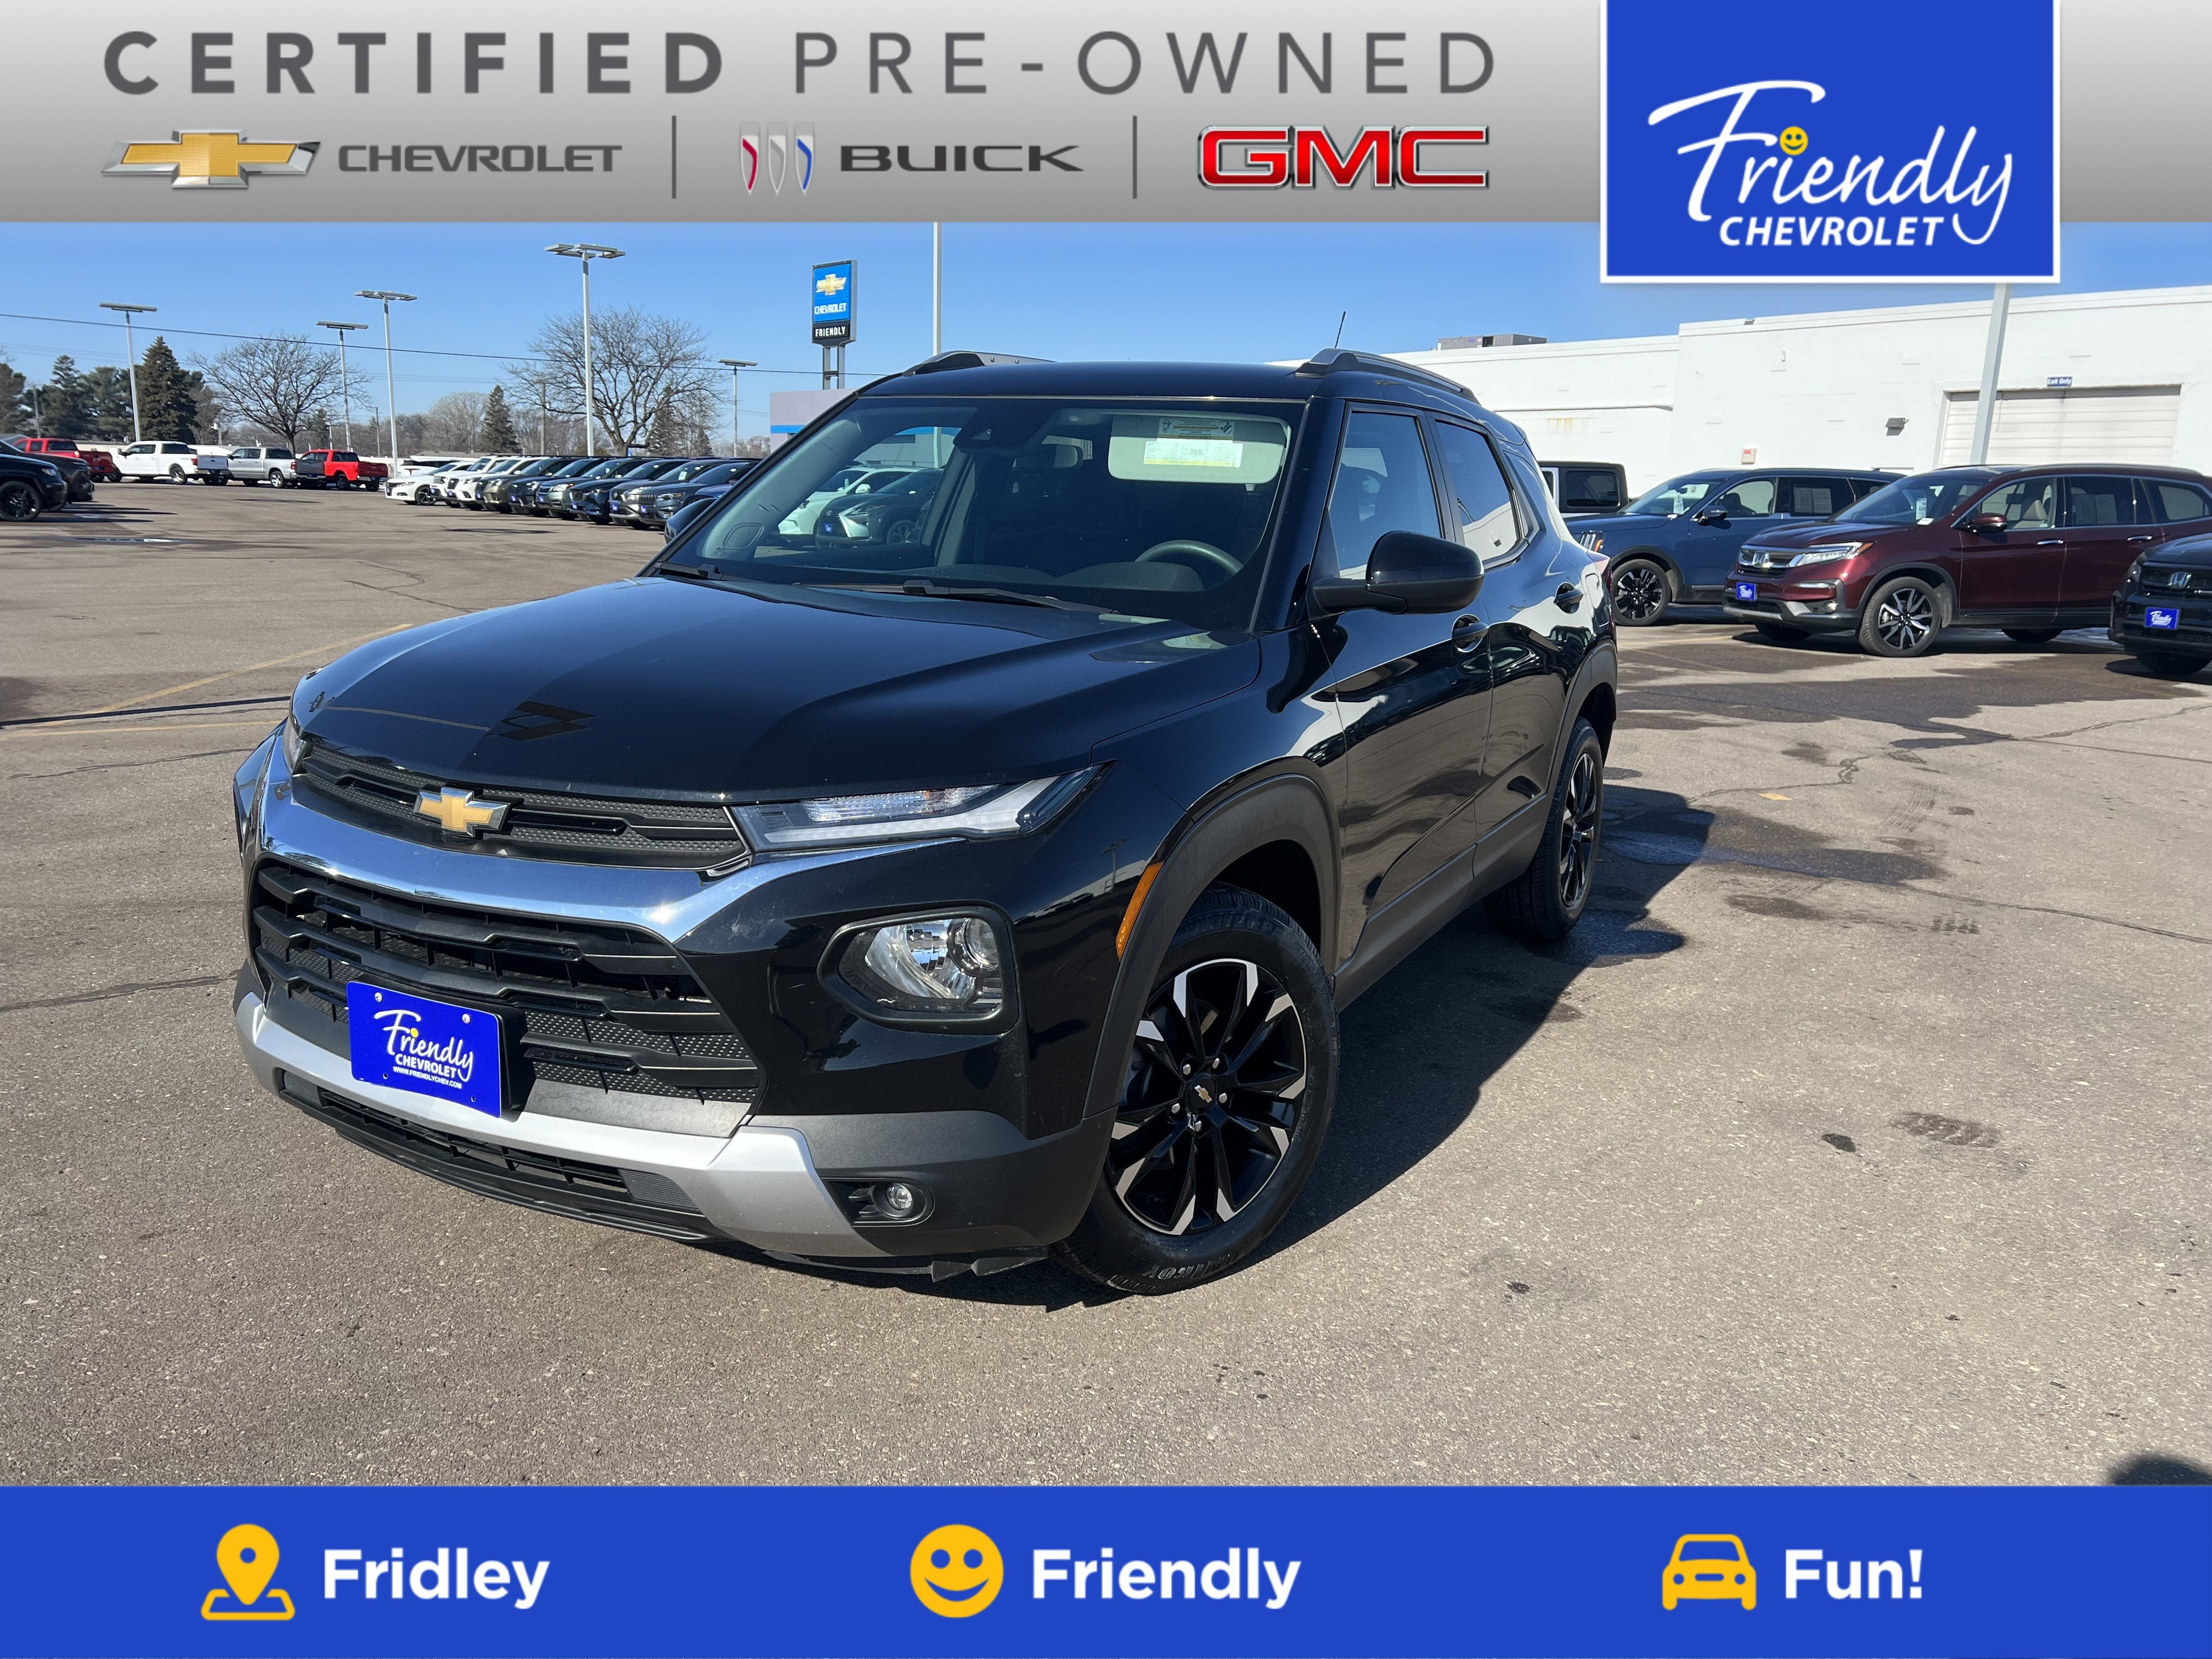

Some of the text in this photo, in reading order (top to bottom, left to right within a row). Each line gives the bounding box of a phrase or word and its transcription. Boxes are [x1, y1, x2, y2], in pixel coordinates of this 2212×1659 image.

[814, 303, 847, 314] CHEVROLET
[815, 326, 846, 337] FRIENDLY
[374, 1009, 473, 1082] Friendly
[395, 1053, 457, 1079] CHEVROLET
